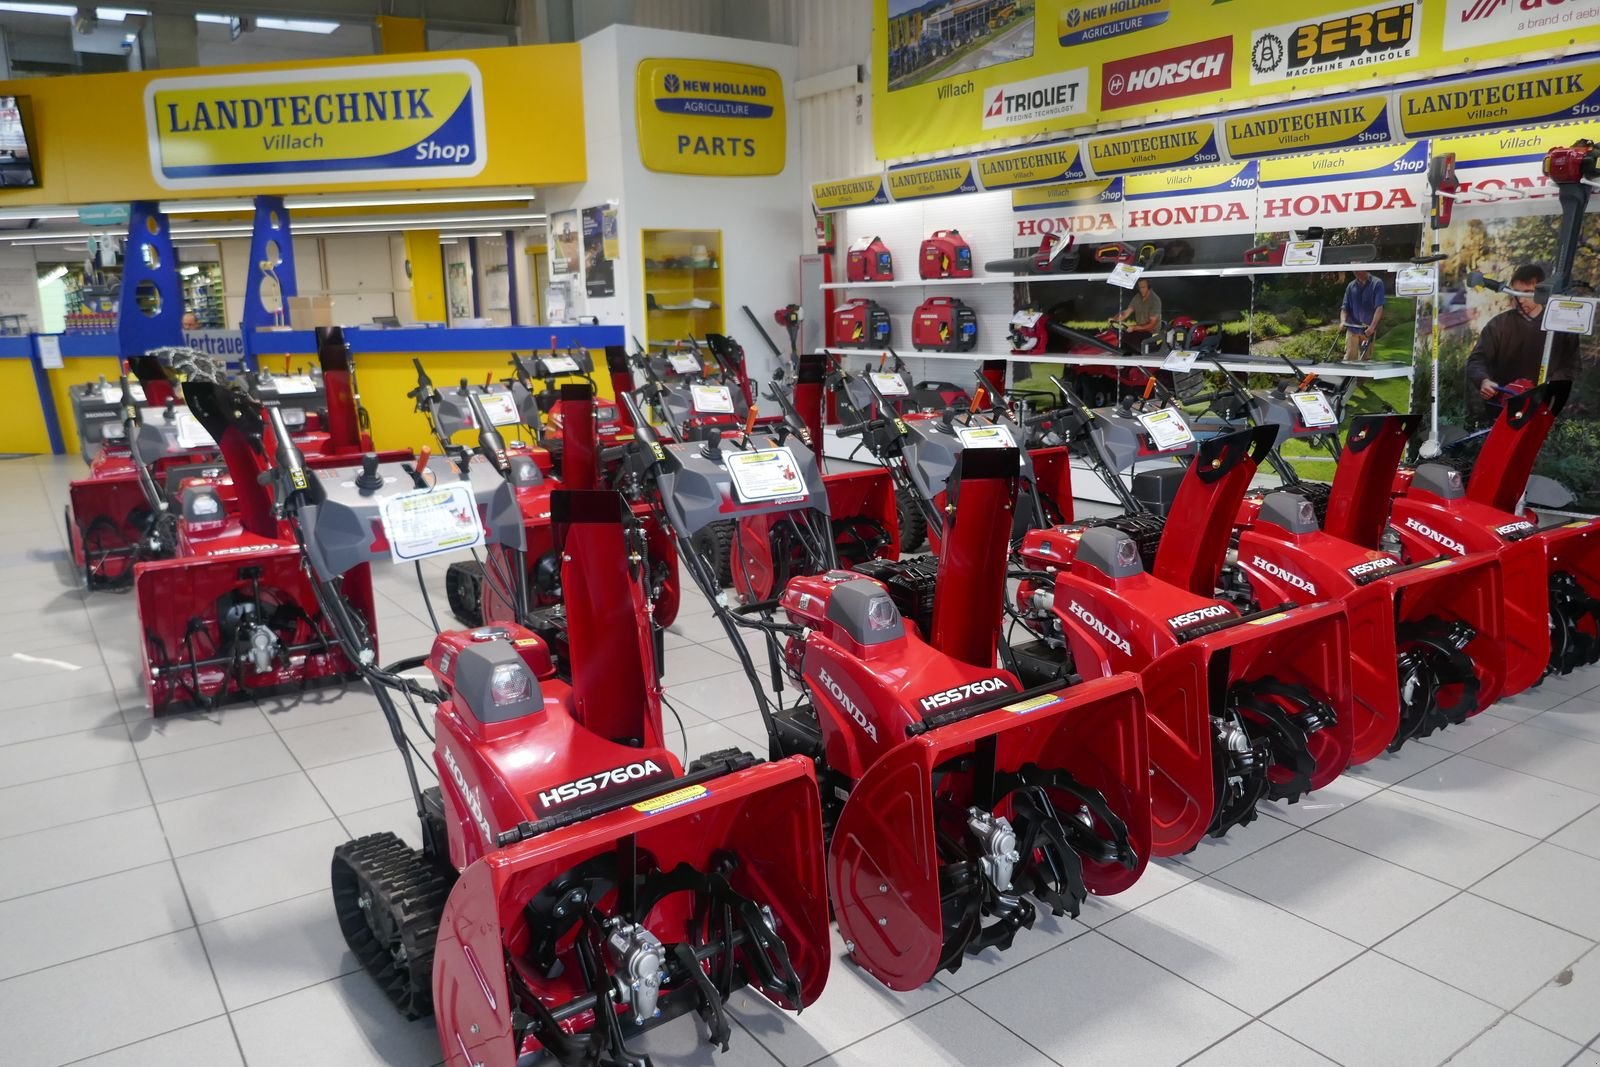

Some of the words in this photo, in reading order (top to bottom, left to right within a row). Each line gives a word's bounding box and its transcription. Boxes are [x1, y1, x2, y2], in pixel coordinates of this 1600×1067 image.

[1083, 6, 1107, 22] NEW
[1517, 22, 1525, 31] a
[1527, 16, 1559, 29] brand
[1562, 11, 1573, 22] of
[1081, 17, 1143, 41] AGRICULTURE
[1126, 52, 1225, 92] HORSCH
[1286, 61, 1344, 78] MACCHINE
[1349, 48, 1411, 67] AGRICOLE
[683, 80, 710, 92] NEW
[713, 82, 767, 97] HOLLAND
[937, 80, 975, 100] Villach
[1004, 82, 1080, 114] TRIOLIET
[1407, 73, 1585, 116] LANDTECHNIK
[168, 88, 433, 133] LANDTECHNIK
[684, 101, 749, 115] AGRICULTURE
[1006, 113, 1033, 123] FEEDING
[1034, 105, 1074, 119] TECHNOLOGY
[1467, 106, 1508, 120] Villach
[1231, 105, 1367, 140] LANDTECHNIK
[263, 134, 324, 151] Villach
[677, 135, 756, 157] PARTS
[1093, 130, 1200, 159] LANDTECHNIK
[1278, 132, 1310, 145] Villach
[1358, 131, 1388, 143] Shop
[1499, 135, 1542, 150] Villach
[415, 141, 470, 163] Shop
[1131, 153, 1156, 163] Villach
[1194, 152, 1217, 164] Shop
[981, 150, 1068, 175] LANDTECHNIK
[1312, 157, 1344, 170] Villach
[1392, 159, 1424, 173] Shop
[890, 167, 962, 188] LANDTECHNIK
[1013, 171, 1035, 180] Villach
[1064, 169, 1084, 180] Shop
[1166, 174, 1193, 185] Villach
[1230, 176, 1255, 190] Shop
[815, 180, 875, 199] LANDTECHNIK
[960, 183, 976, 193] Shop
[1047, 188, 1070, 198] Villach
[1100, 191, 1121, 202] Shop
[1262, 187, 1416, 219] HONDA
[1017, 212, 1117, 236] HONDA
[1128, 202, 1250, 228] HONDA
[185, 333, 244, 354] ertraue
[1404, 517, 1466, 556] HONDA
[1251, 555, 1317, 596] HONDA
[1348, 557, 1397, 577] HSS760A
[1168, 605, 1231, 628] HSS760A
[1068, 600, 1133, 657] HONDA
[920, 677, 1008, 711] HSS760A
[818, 667, 878, 744] HONDA
[538, 759, 662, 808] HSS760A
[444, 745, 492, 844] HONDA
